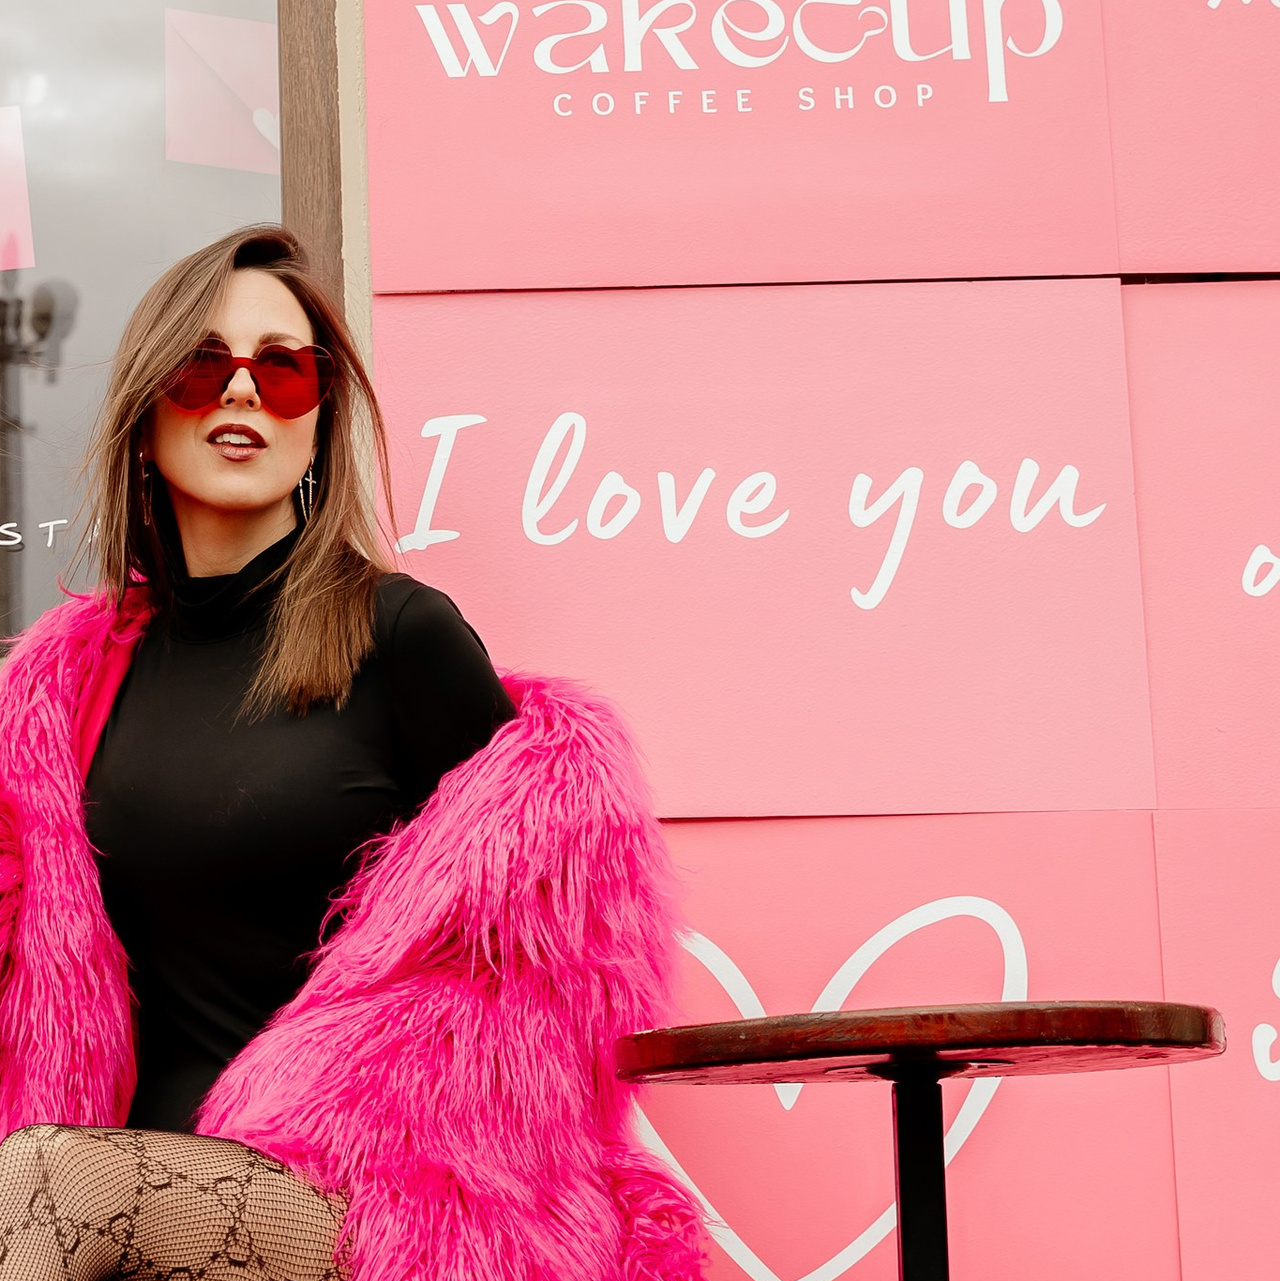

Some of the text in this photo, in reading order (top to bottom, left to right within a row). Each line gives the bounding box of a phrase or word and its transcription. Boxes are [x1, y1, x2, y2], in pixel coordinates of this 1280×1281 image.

[553, 84, 935, 117] COFFEE SHOP
[395, 412, 1106, 610] I love you
